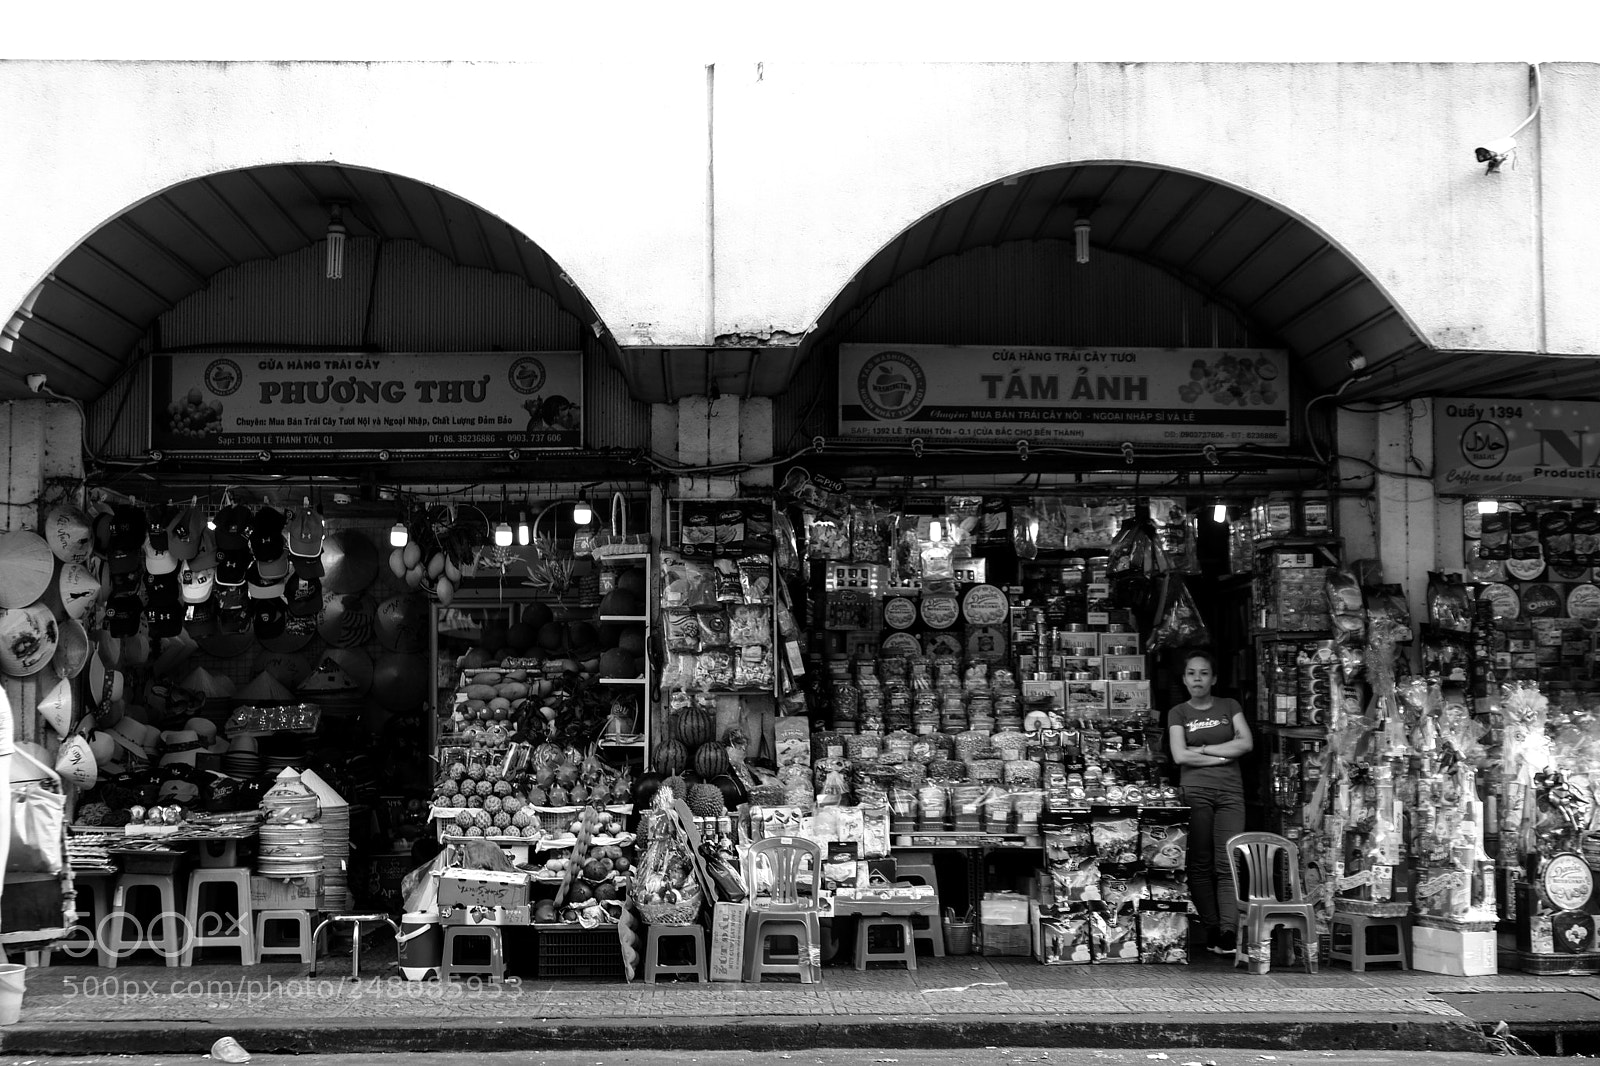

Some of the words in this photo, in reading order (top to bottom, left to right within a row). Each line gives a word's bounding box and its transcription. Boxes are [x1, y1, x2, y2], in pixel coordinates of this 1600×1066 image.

[992, 348, 1016, 361] CỬA
[1019, 350, 1051, 362] HÀNG
[1054, 350, 1080, 362] TRÁI
[1111, 352, 1136, 363] TƯƠI
[258, 358, 284, 370] CỬA
[288, 359, 321, 370] HÀNG
[324, 359, 351, 370] TRÁI
[355, 359, 380, 370] CÂY
[259, 375, 406, 404] PHƯƠNG
[414, 374, 490, 403] THƯ
[981, 368, 1058, 400] TÁM
[1071, 366, 1148, 400] ẢNH
[971, 411, 992, 419] MUA
[1489, 407, 1522, 418] 1394
[269, 417, 284, 426] Mua
[287, 417, 302, 426] Bán
[304, 416, 320, 426] Trái
[323, 416, 336, 427] Cây
[372, 417, 381, 425] và
[384, 416, 405, 427] Ngoại
[497, 415, 512, 424] Bảo
[872, 427, 890, 435] 1392
[238, 435, 260, 444] 1390A
[275, 434, 301, 444] THÁNH
[323, 435, 334, 444] Q1
[458, 434, 495, 443] 38236886
[531, 433, 545, 442] 737
[547, 433, 562, 442] 606
[1447, 469, 1480, 484] Coffee
[1483, 472, 1503, 482] and
[1506, 472, 1522, 482] tea
[1185, 718, 1221, 732] Venice
